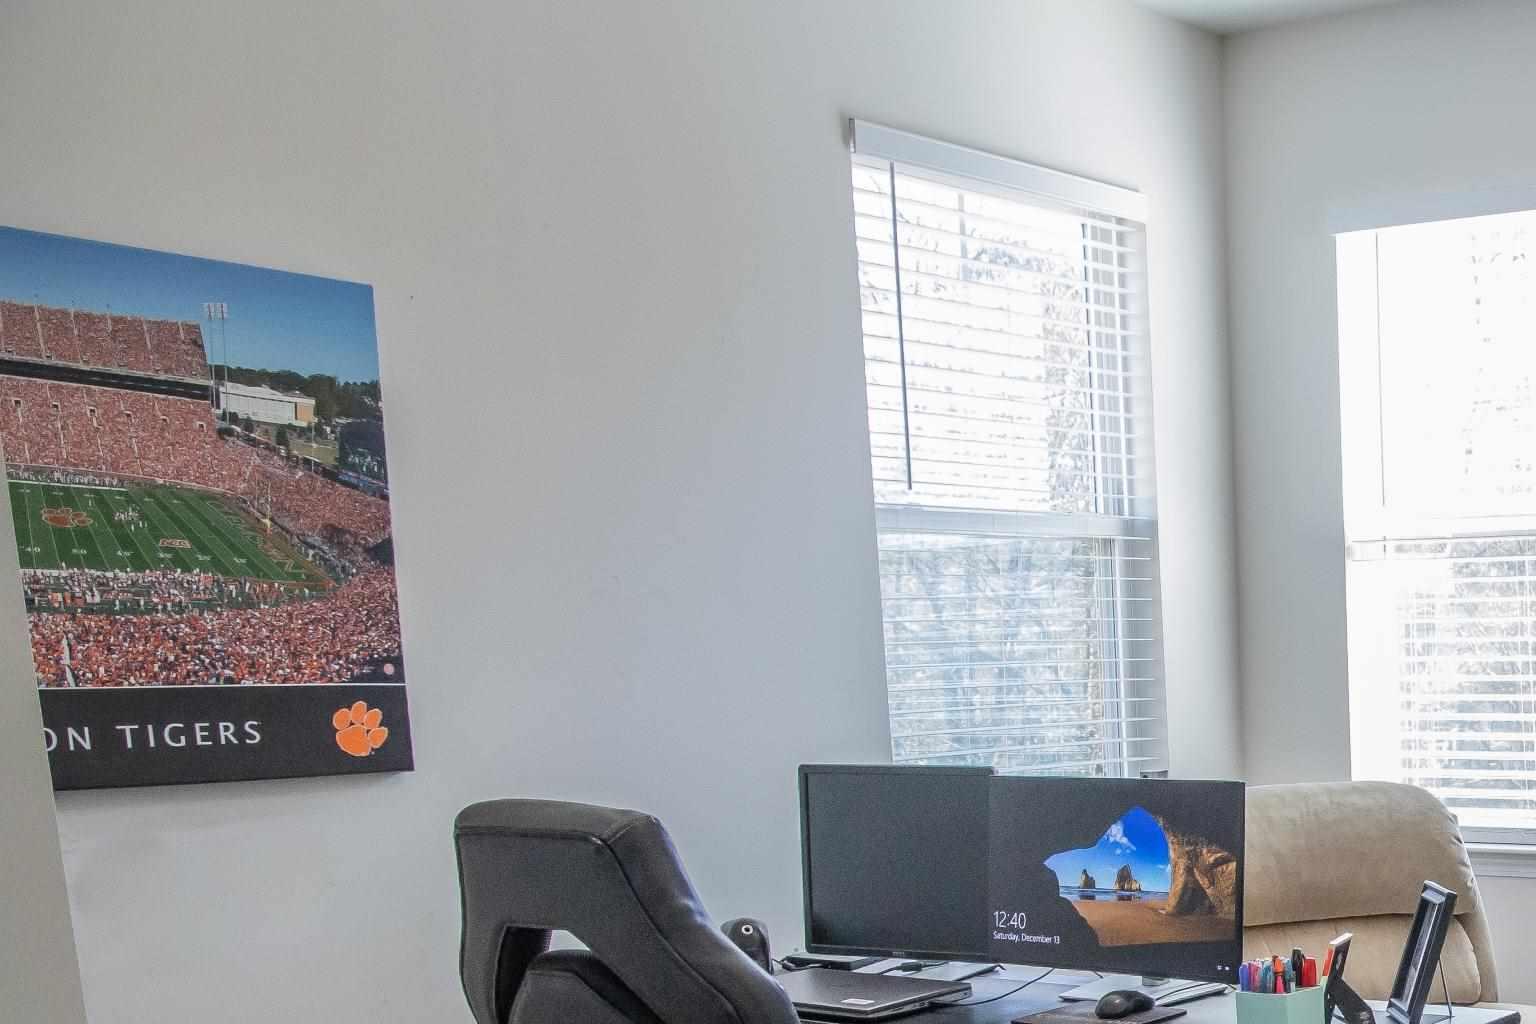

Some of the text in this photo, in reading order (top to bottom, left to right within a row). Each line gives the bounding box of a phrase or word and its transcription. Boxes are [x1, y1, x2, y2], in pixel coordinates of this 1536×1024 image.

[44, 720, 262, 753] ON TIGERS
[993, 911, 1027, 929] 12:40
[1021, 933, 1052, 943] December
